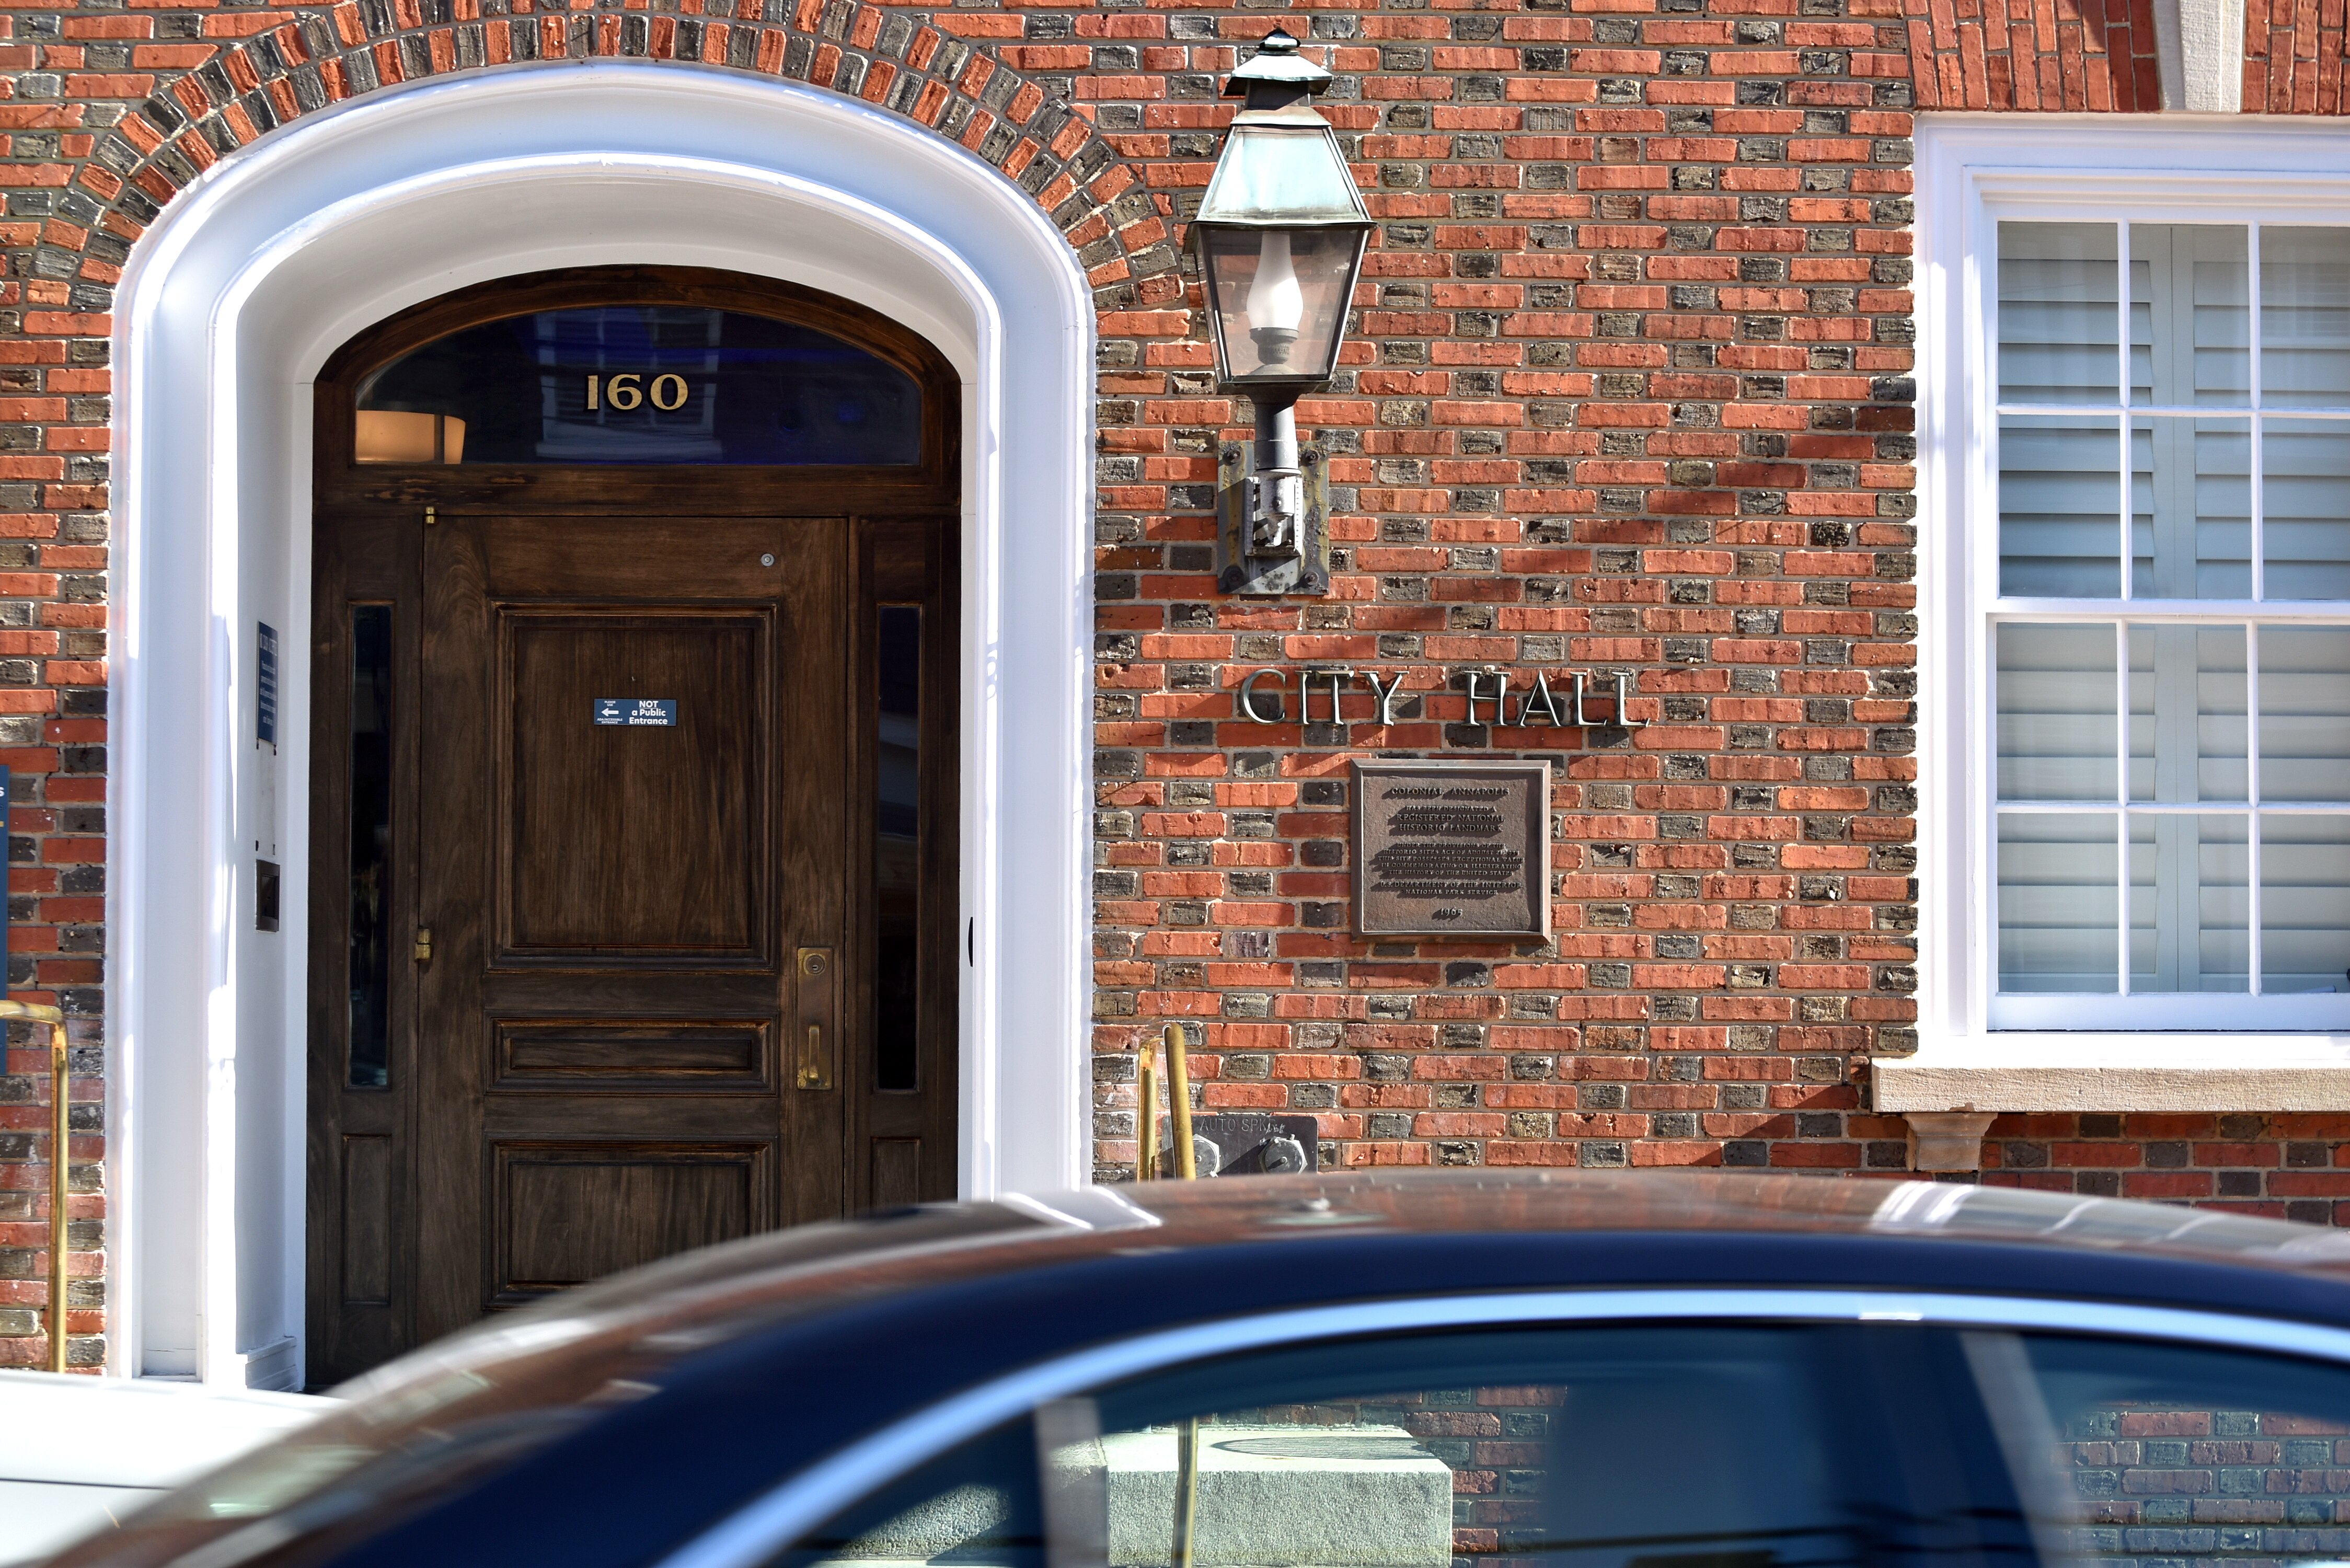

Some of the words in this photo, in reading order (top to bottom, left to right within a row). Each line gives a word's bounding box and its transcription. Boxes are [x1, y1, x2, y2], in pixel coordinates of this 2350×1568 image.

[587, 374, 689, 410] 160
[1238, 668, 1410, 727] CITY
[1465, 670, 1651, 728] HALL
[1441, 907, 1462, 916] 1965
[1200, 1117, 1237, 1132] AUTO
